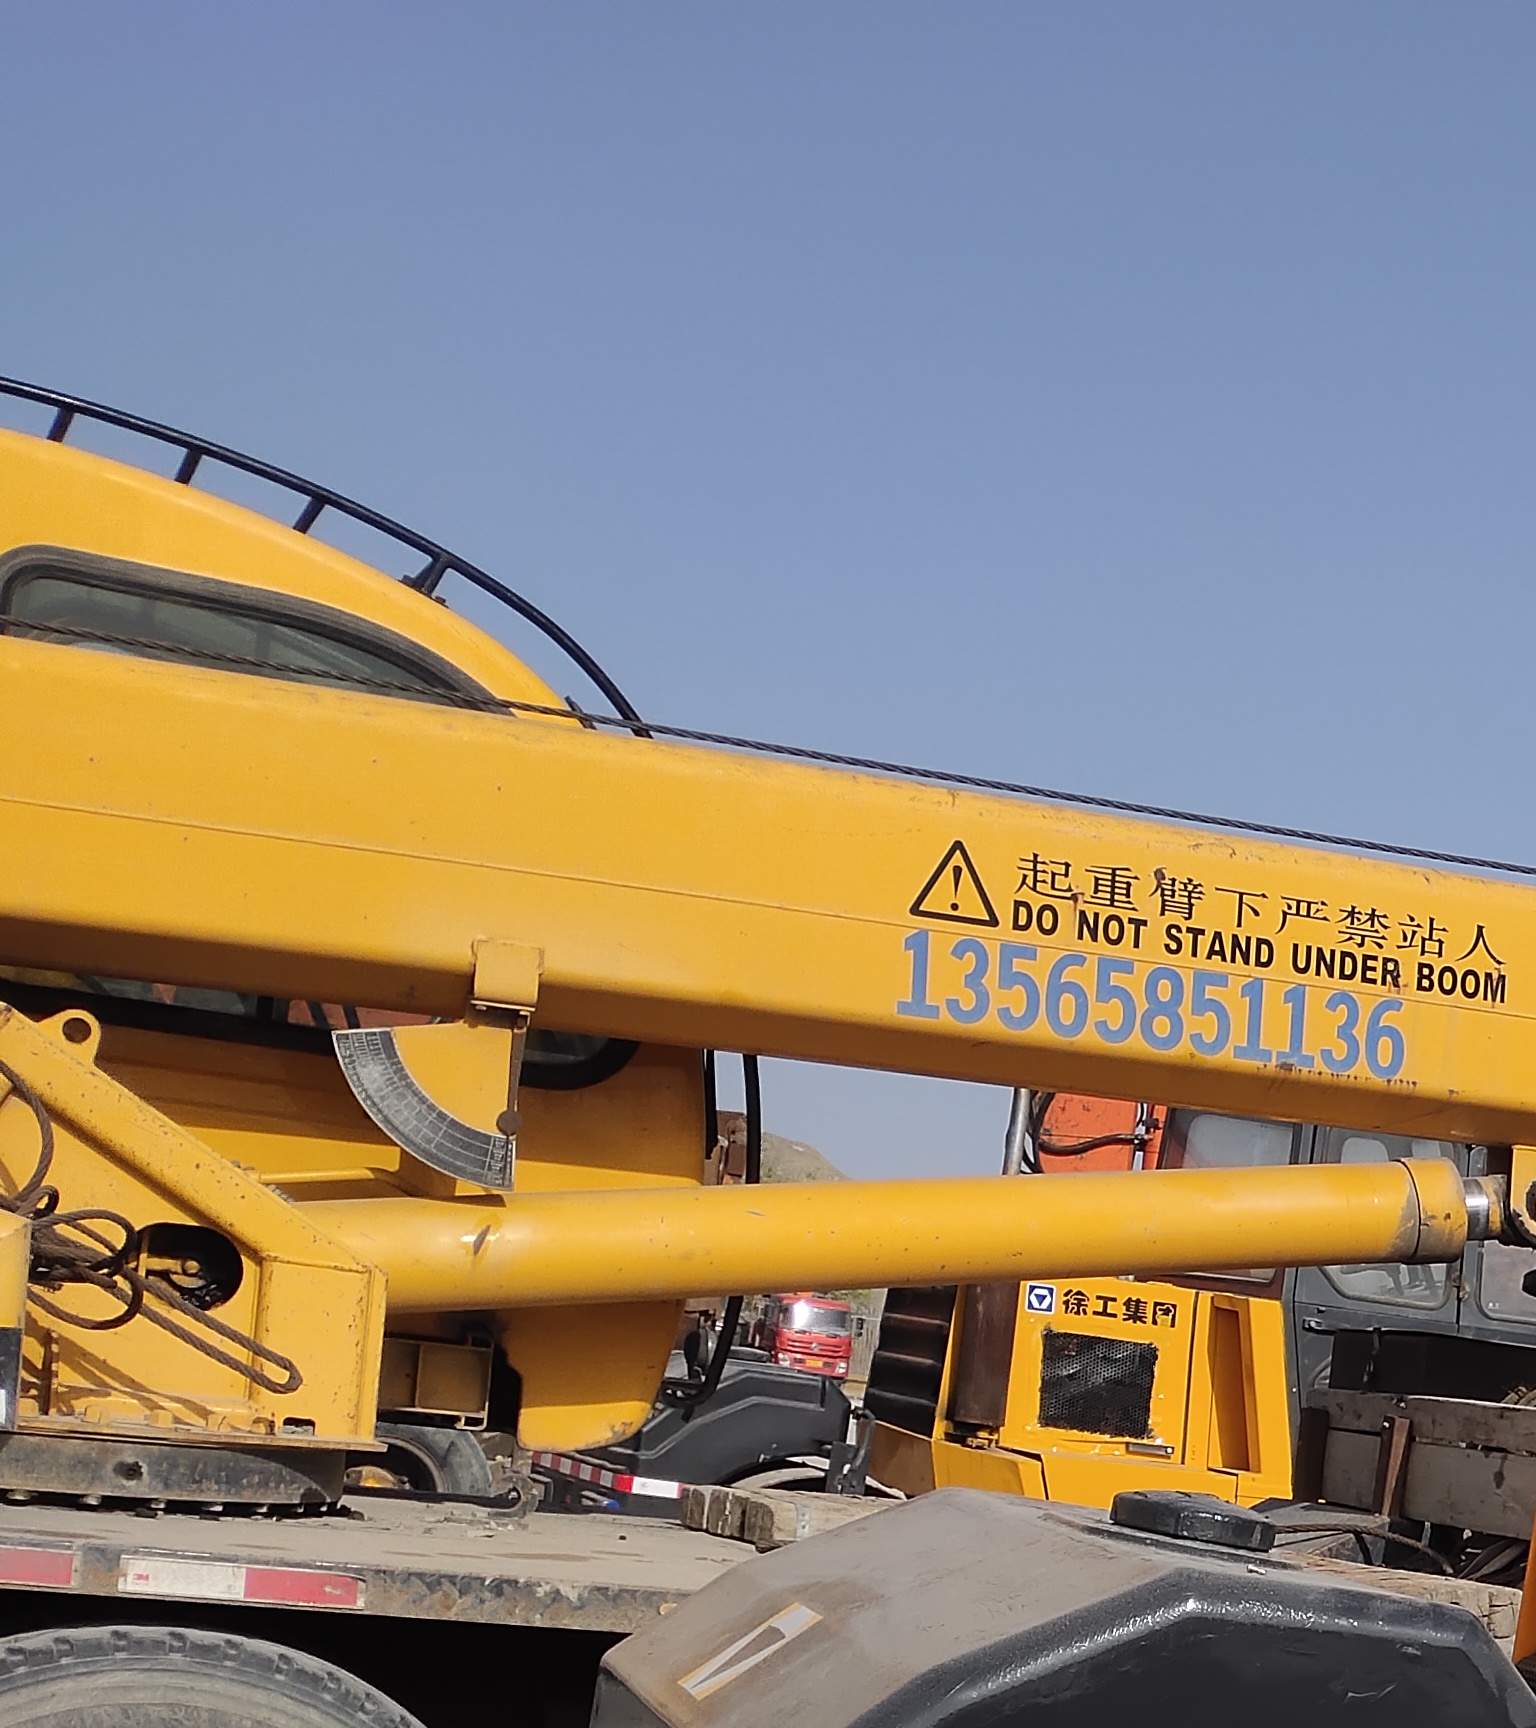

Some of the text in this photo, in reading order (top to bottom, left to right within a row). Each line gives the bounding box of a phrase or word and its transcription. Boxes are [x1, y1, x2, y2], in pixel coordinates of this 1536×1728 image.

[1011, 899, 1507, 1004] DO NOT STAND UNDER BOOM
[1013, 852, 1508, 966] 起重臂下严禁站人
[896, 928, 1406, 1079] 13565851136
[1063, 1288, 1178, 1329] 徐工集团
